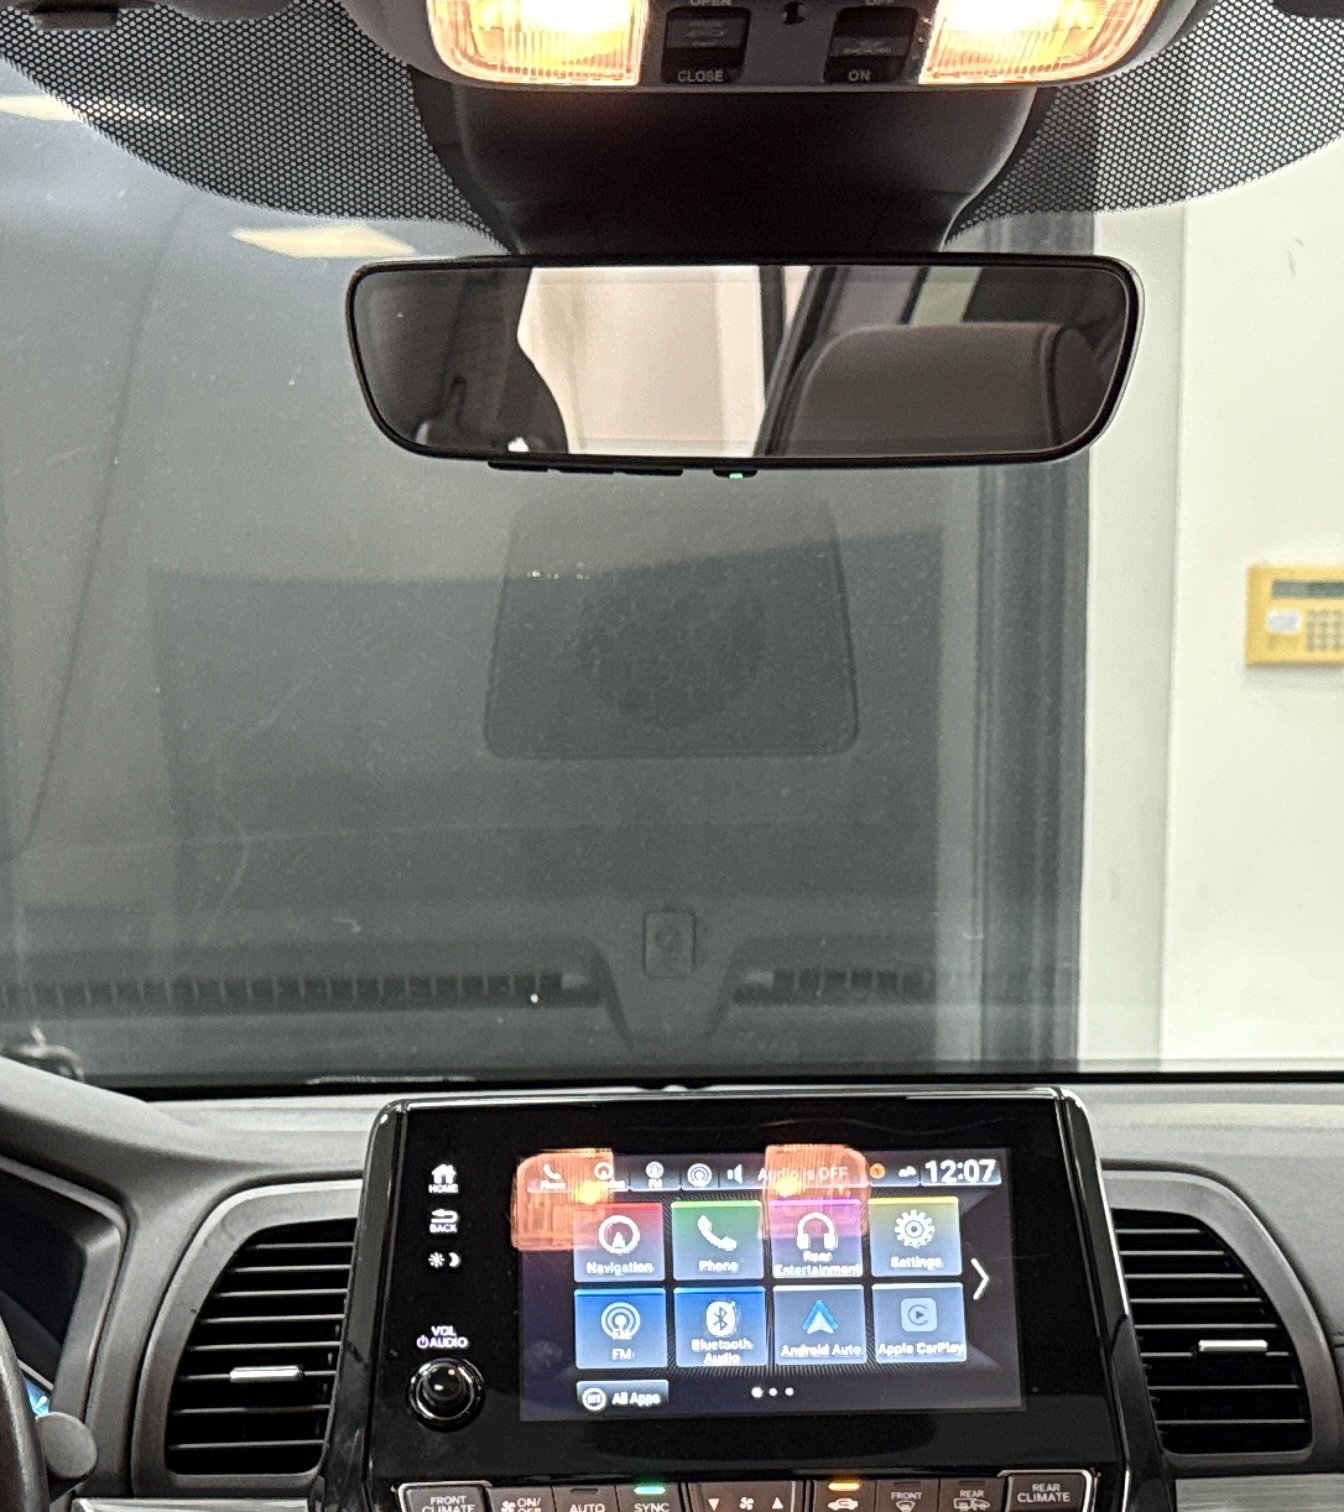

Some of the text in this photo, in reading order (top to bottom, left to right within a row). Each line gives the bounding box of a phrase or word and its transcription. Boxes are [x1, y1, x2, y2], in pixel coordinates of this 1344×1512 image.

[677, 70, 724, 83] CLOSE
[848, 70, 871, 82] ON
[818, 1166, 848, 1181] OFF
[925, 1159, 997, 1183] 12:07
[803, 1251, 833, 1262] Rear
[586, 1261, 654, 1276] Navigation
[698, 1260, 739, 1273] Phone
[890, 1256, 944, 1271] Settings
[774, 1264, 862, 1276] Entertainment
[431, 1325, 456, 1336] VOL
[429, 1336, 469, 1348] AUDIO
[691, 1338, 753, 1351] Bluetooth
[611, 1349, 633, 1360] FM
[780, 1344, 862, 1357] Android Auto
[878, 1341, 965, 1357] Apple CarPlay
[704, 1353, 741, 1365] Audio
[611, 1392, 661, 1407] All Apps
[960, 1489, 984, 1499] REAR
[1031, 1483, 1061, 1493] REAR
[429, 1495, 467, 1506] FRONT
[890, 1491, 922, 1500] FRONT
[1017, 1491, 1071, 1503] CLIMATE
[517, 1497, 542, 1508] ON/
